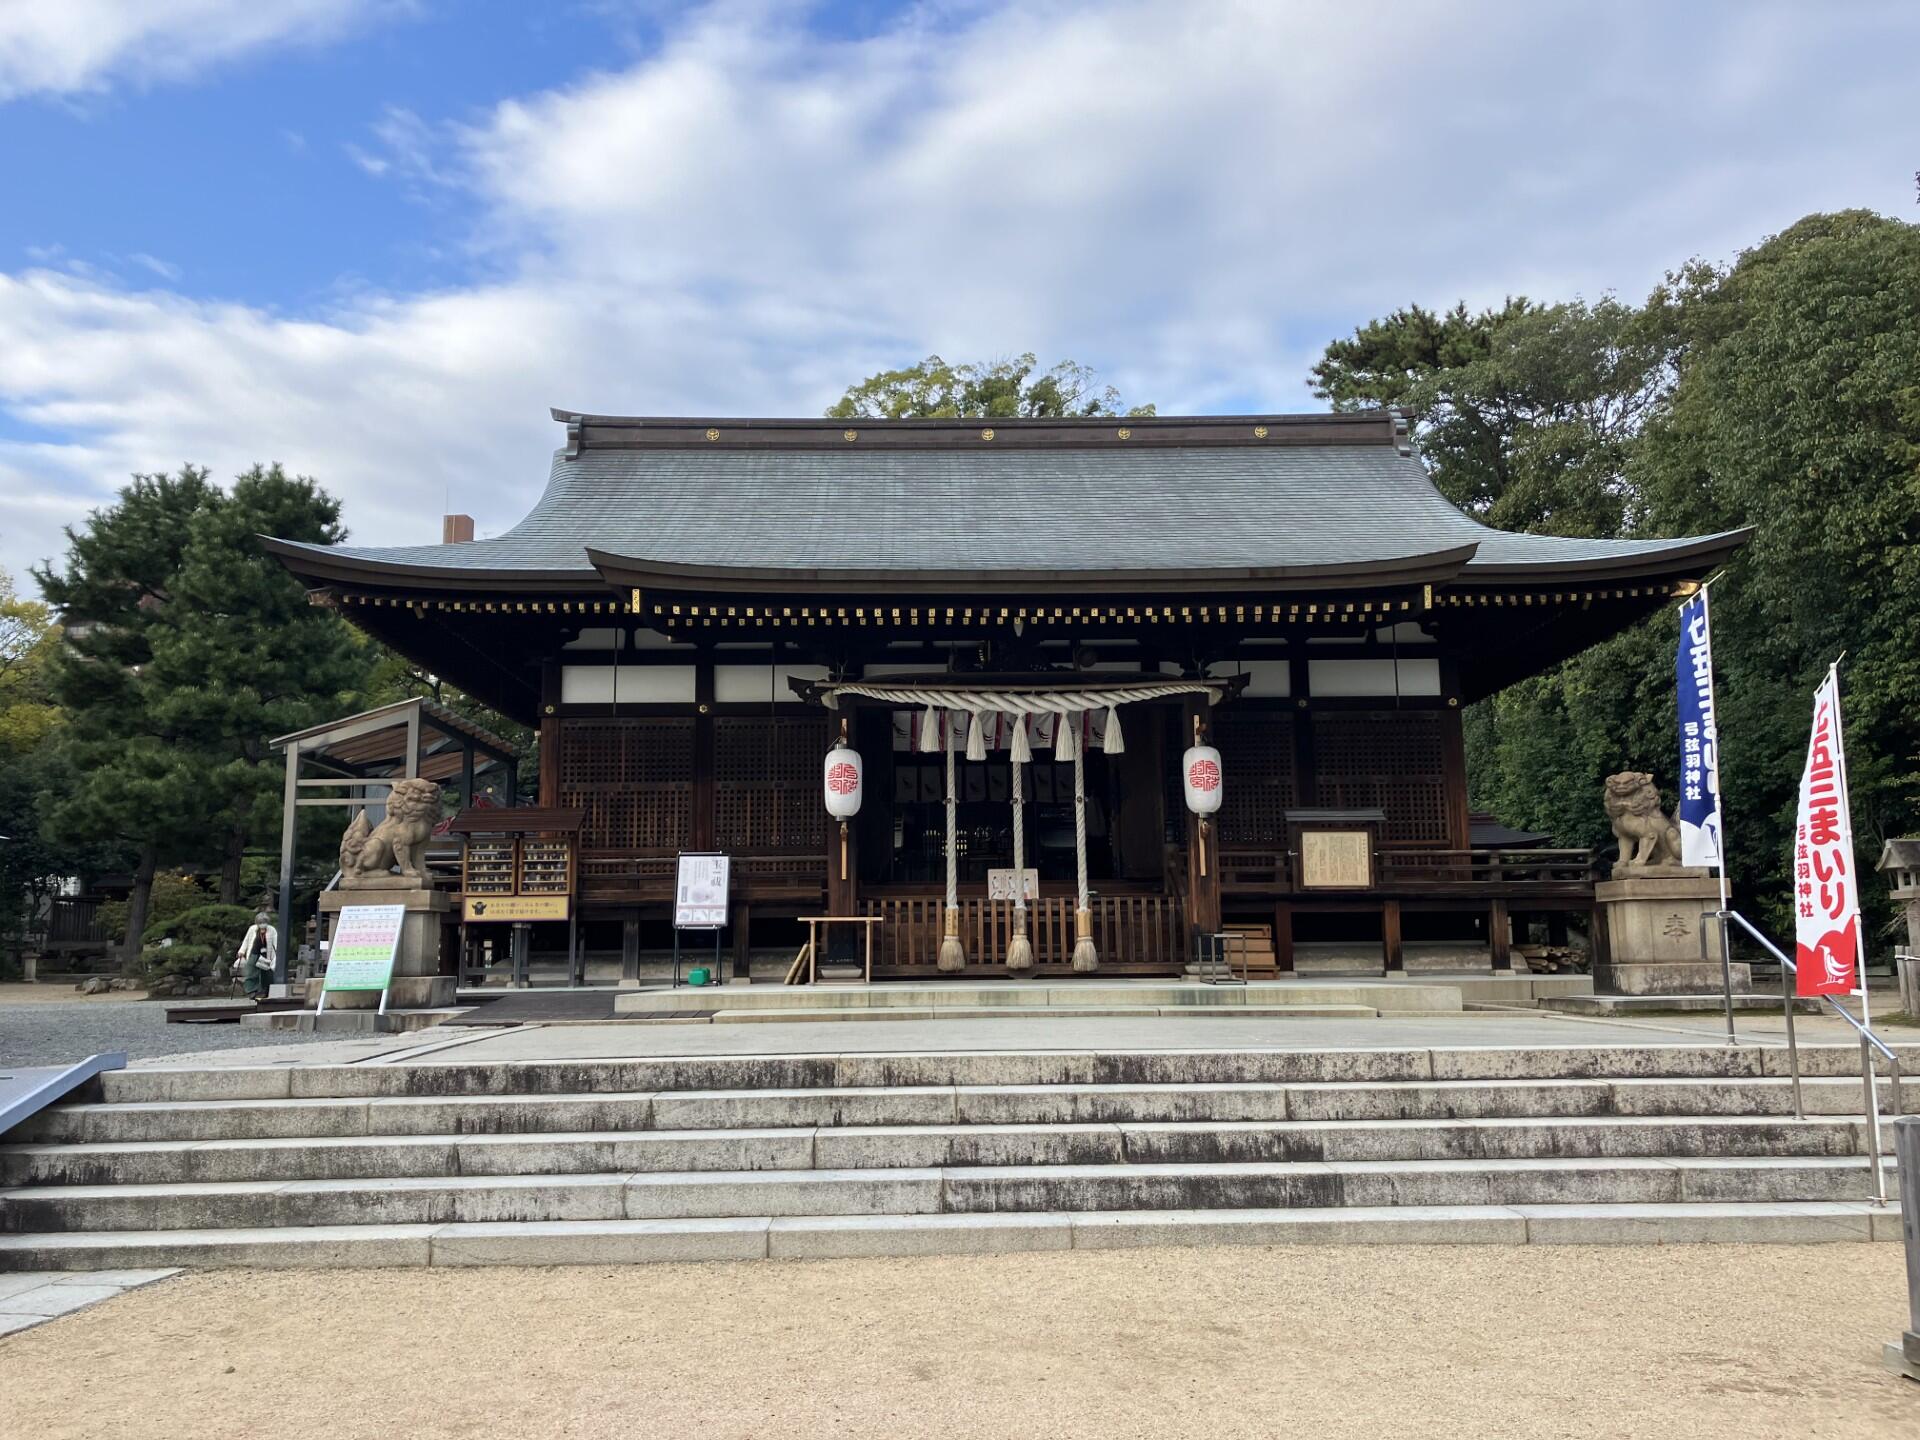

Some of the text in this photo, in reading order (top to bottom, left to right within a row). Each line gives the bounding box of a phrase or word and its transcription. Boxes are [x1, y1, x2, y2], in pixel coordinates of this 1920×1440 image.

[1684, 721, 1702, 800] 弓弦羽神社
[1809, 701, 1846, 920] 七五三まいり
[1797, 824, 1814, 918] 弓弦羽神社
[1663, 913, 1692, 944] 奉
